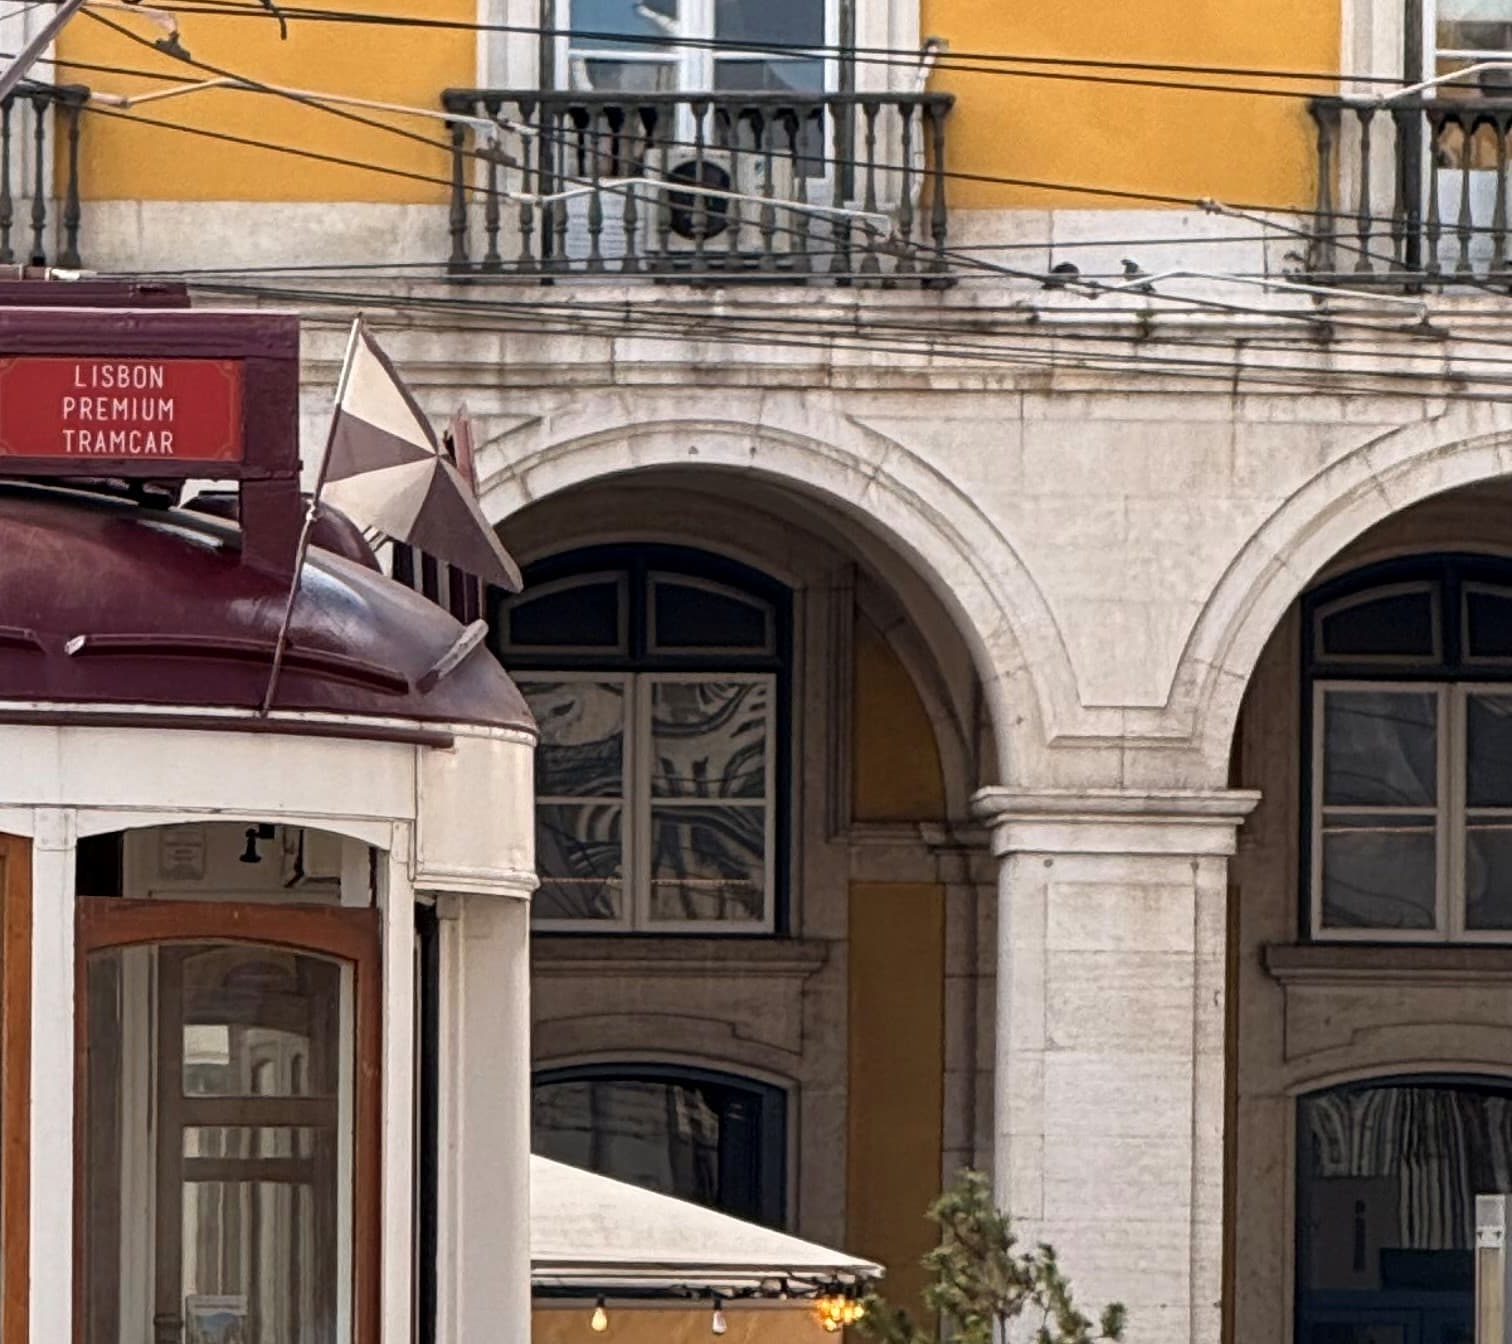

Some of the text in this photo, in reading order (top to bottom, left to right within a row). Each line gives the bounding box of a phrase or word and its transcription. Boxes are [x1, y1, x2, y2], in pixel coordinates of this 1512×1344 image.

[74, 364, 164, 389] LISBON
[63, 396, 174, 421] PREMIUM
[62, 429, 174, 454] TRAMCAR
